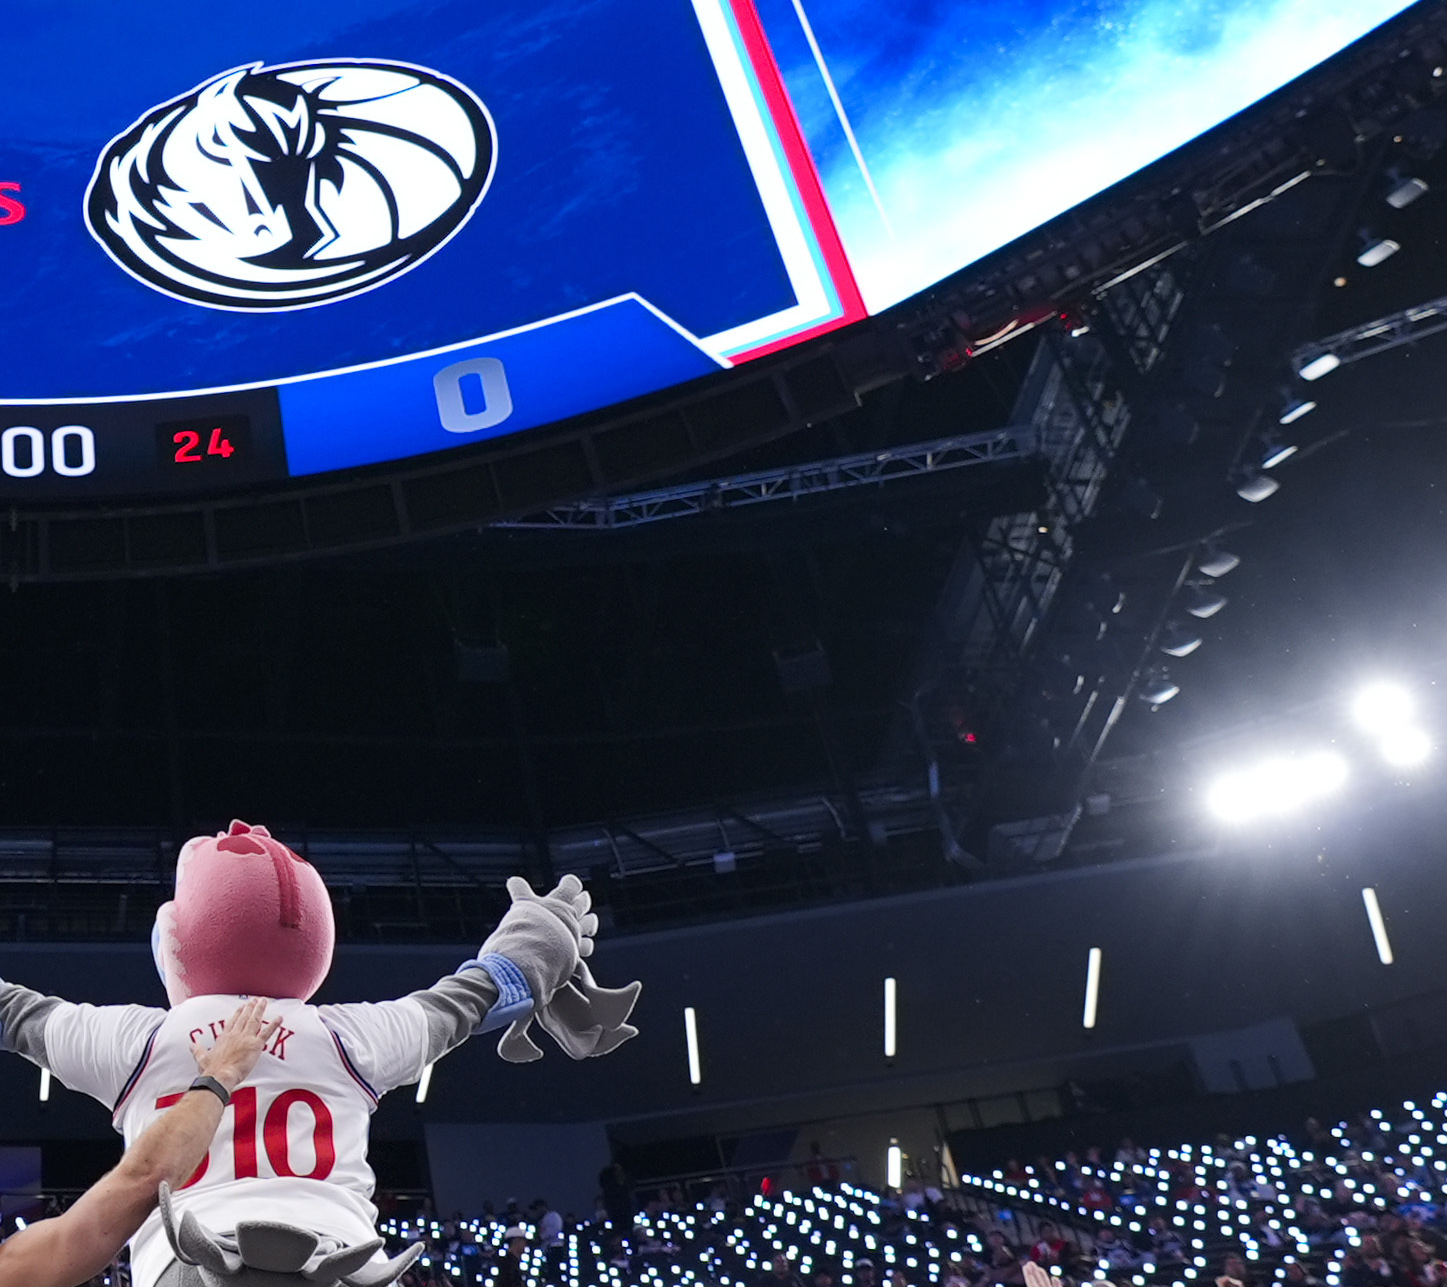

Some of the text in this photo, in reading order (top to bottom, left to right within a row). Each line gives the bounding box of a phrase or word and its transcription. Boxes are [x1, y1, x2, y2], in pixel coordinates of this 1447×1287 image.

[433, 357, 513, 433] 0
[172, 428, 235, 463] 24
[155, 1087, 335, 1190] 10
